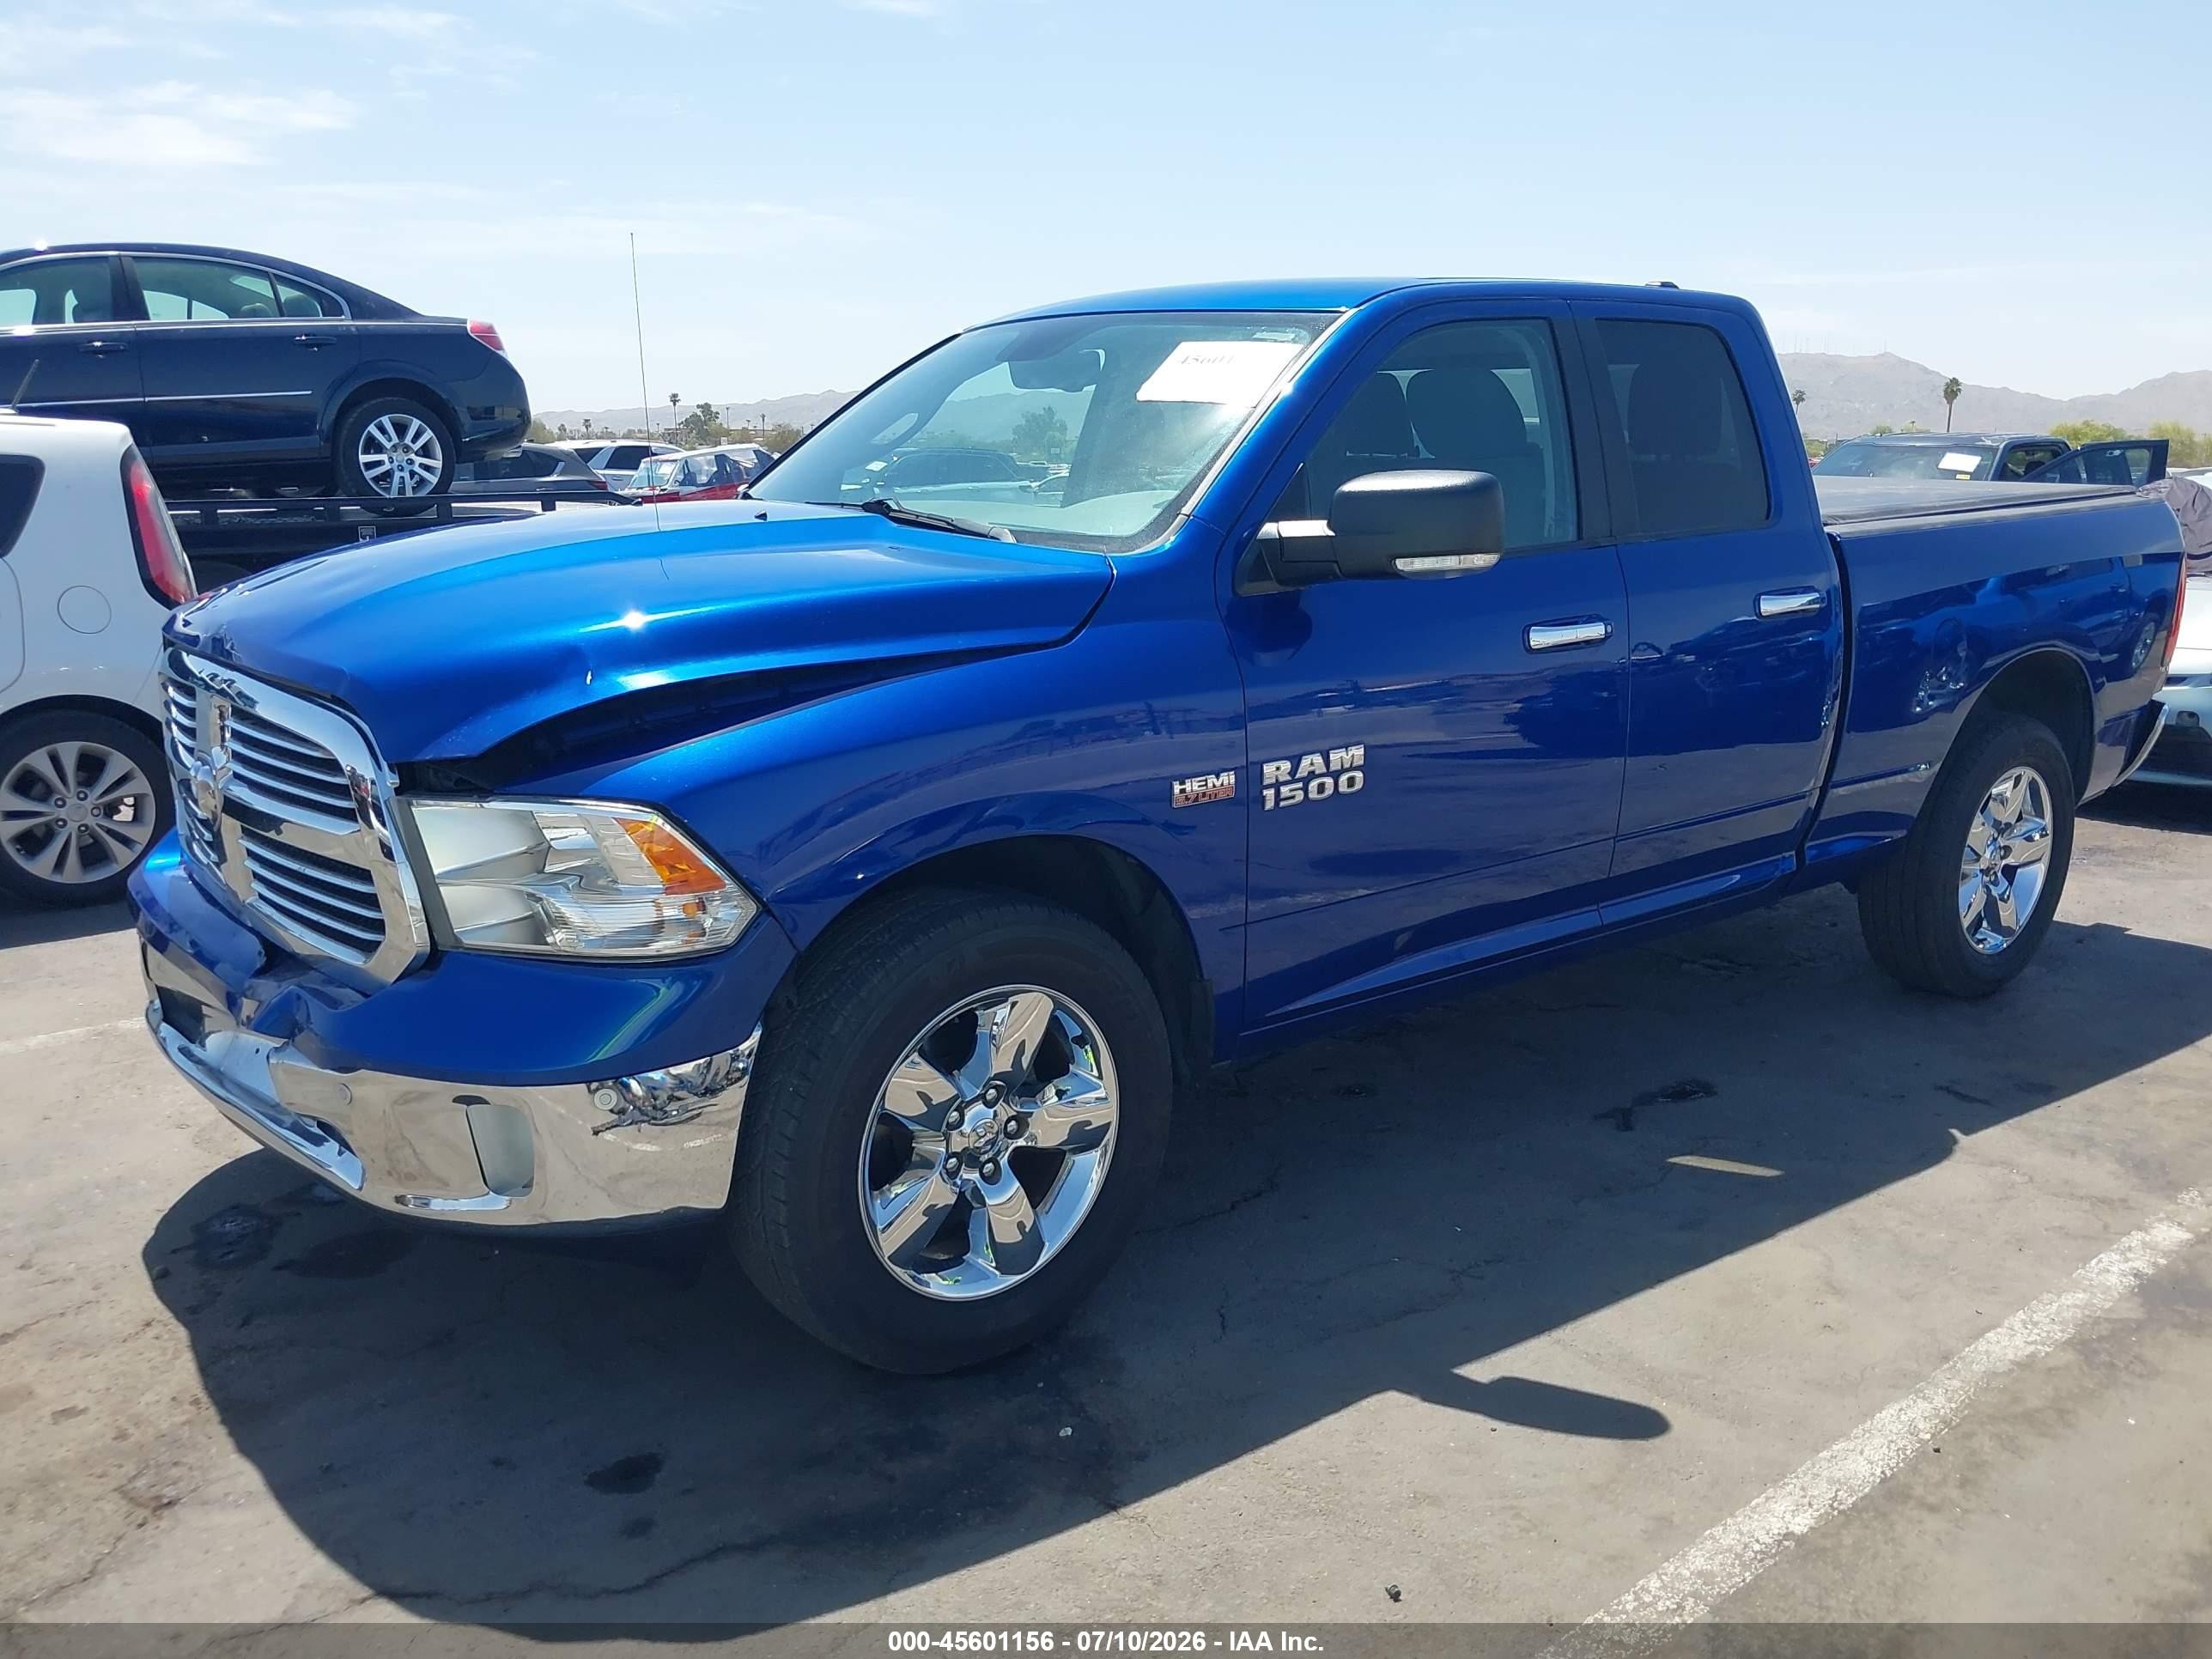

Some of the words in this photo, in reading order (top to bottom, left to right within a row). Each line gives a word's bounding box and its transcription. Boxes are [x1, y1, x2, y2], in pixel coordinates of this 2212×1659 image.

[1262, 744, 1364, 785] RAM
[1173, 771, 1235, 794] HEMI
[1176, 793, 1197, 805] 5.7
[1198, 786, 1233, 802] LITER
[1262, 770, 1364, 811] 1500
